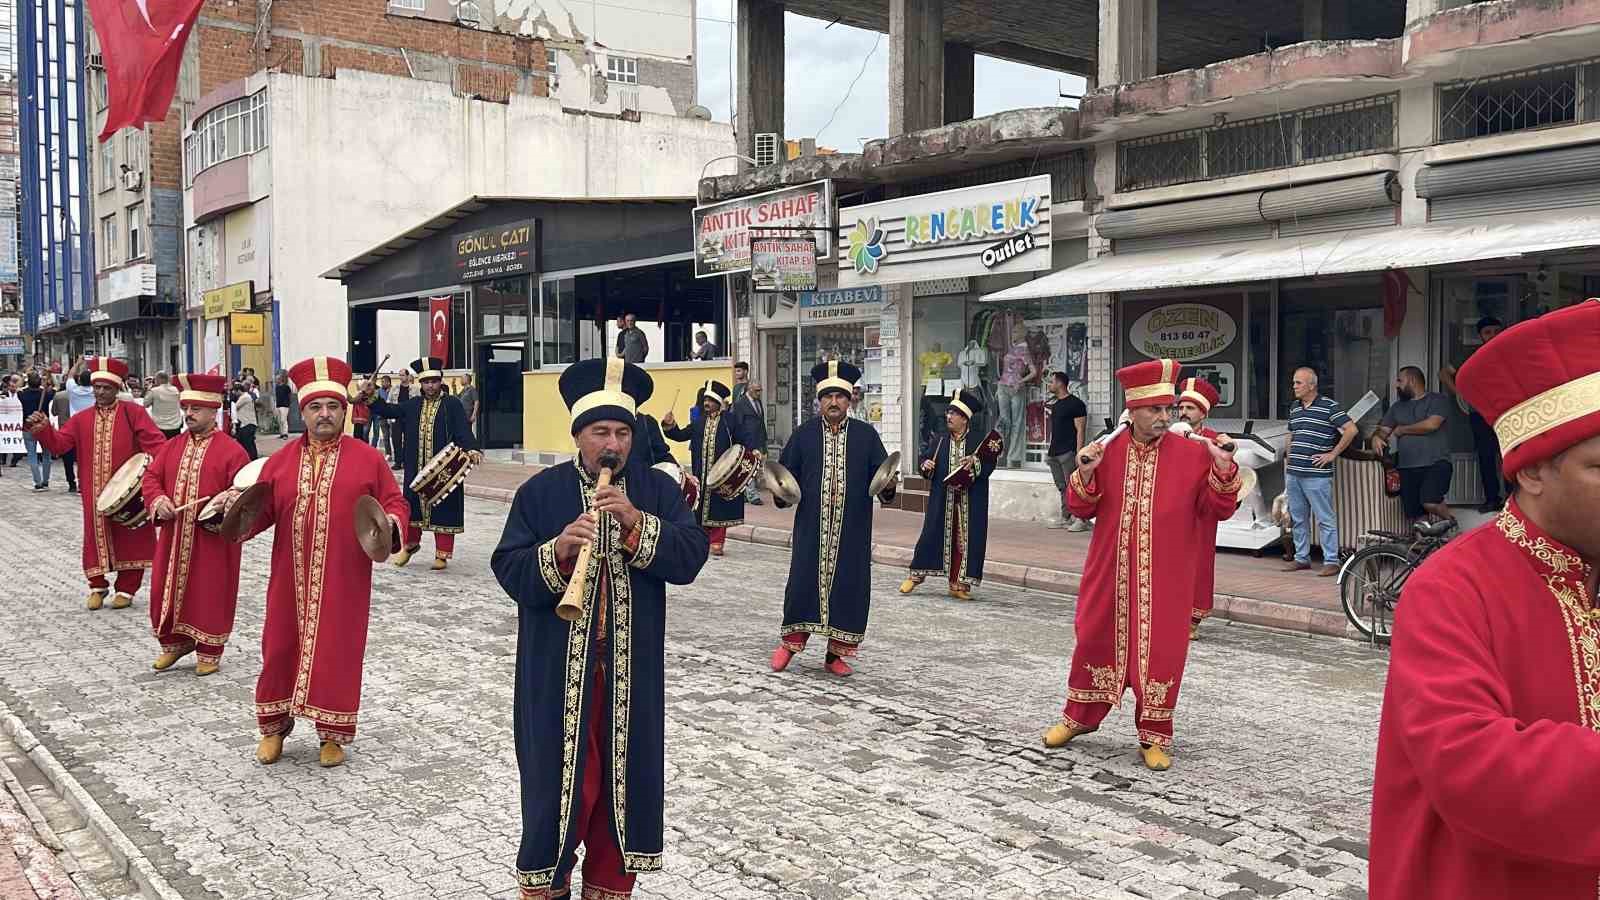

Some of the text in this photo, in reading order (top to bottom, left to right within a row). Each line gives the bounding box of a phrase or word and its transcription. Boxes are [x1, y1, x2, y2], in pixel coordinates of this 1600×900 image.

[702, 192, 818, 233] ANTİK SAHAF
[906, 196, 1038, 244] RENGARENK
[501, 226, 529, 251] ÇATI
[784, 242, 815, 253] SAHAF
[982, 234, 1033, 267] Outlet
[1147, 306, 1220, 333] ÖZEN
[1160, 330, 1210, 341] 813 60 47
[3, 437, 11, 445] 19
